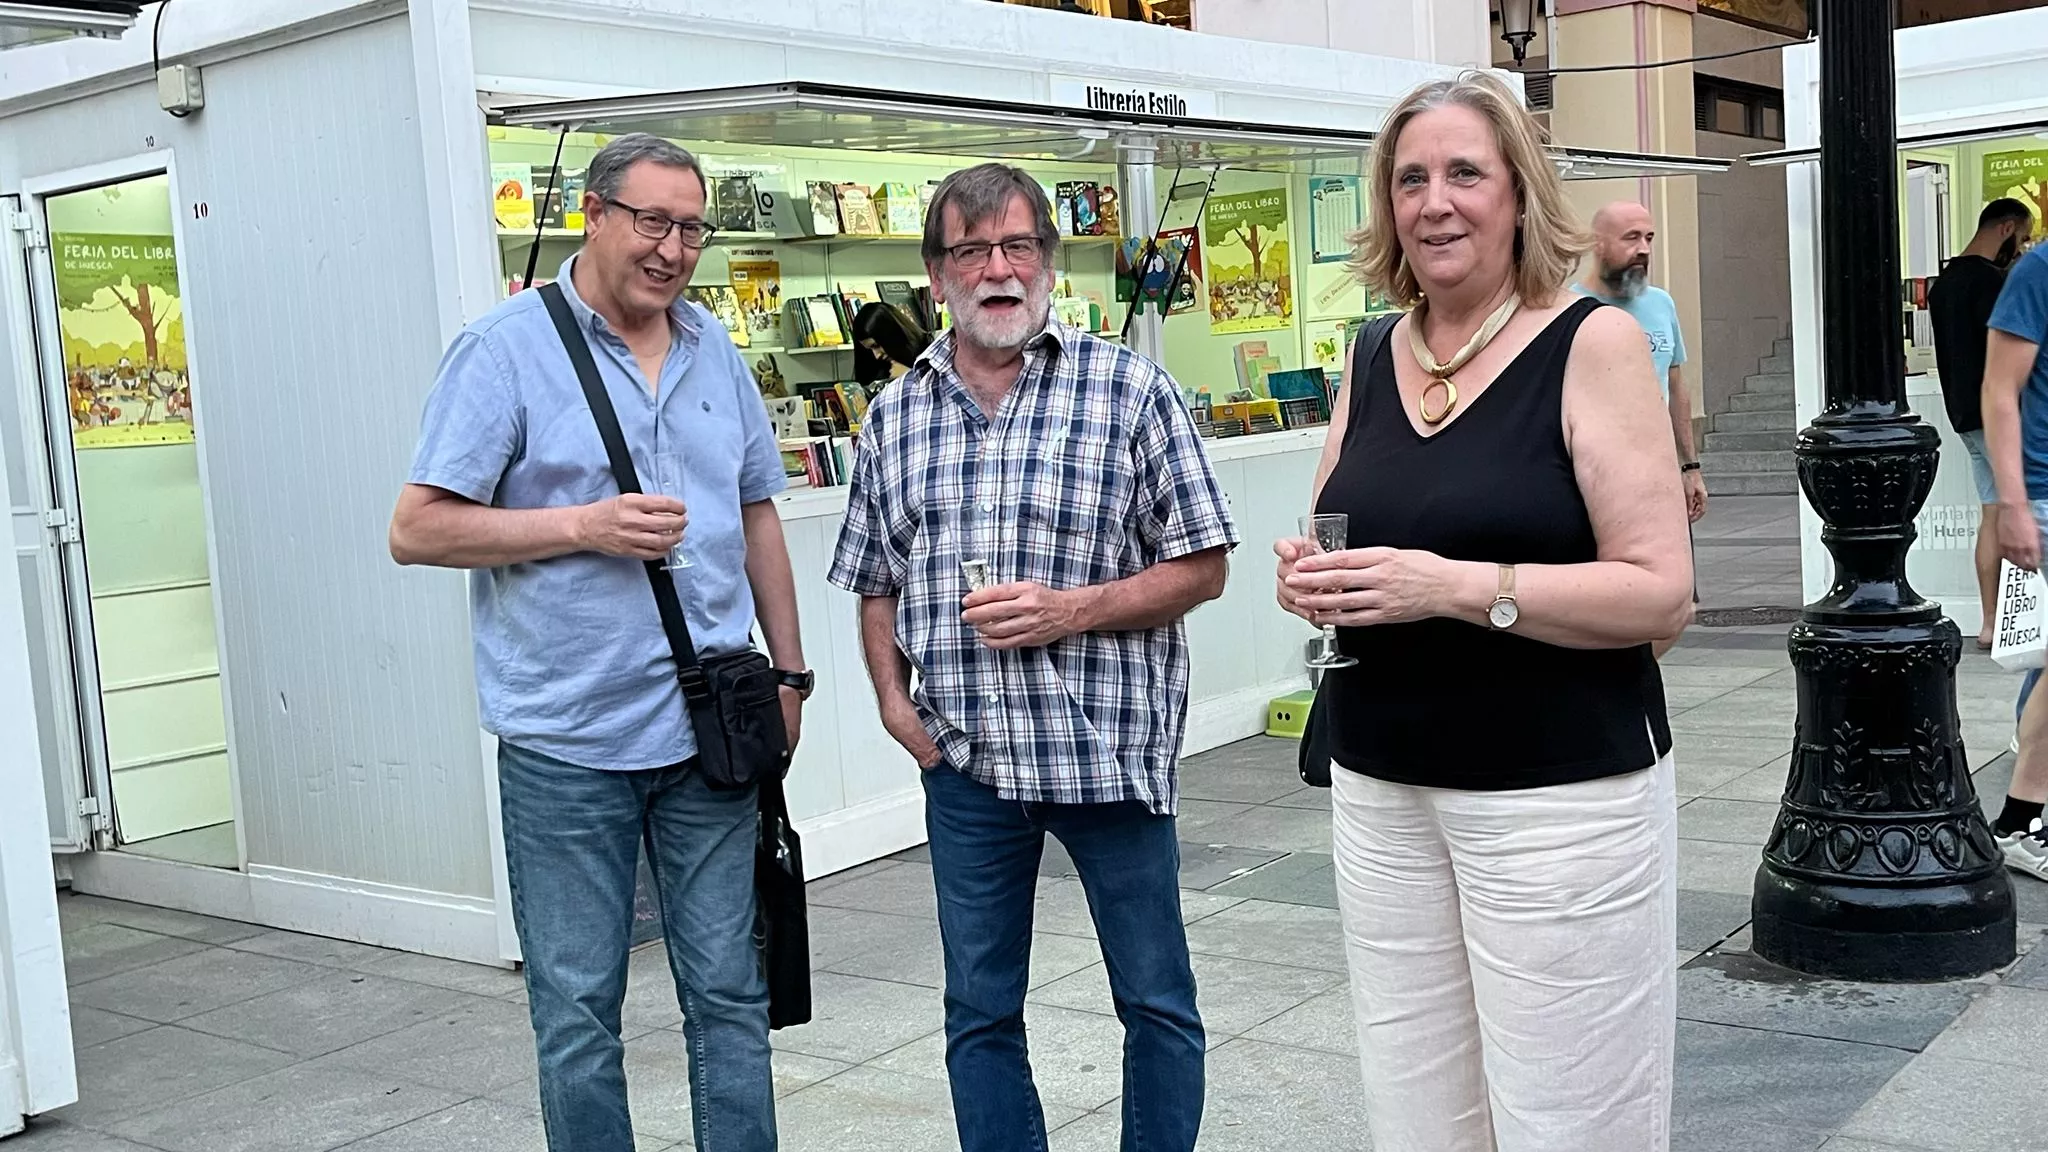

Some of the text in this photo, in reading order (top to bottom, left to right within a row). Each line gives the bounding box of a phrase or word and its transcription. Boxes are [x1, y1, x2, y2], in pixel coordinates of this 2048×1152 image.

[1086, 86, 1146, 113] Librería
[145, 135, 155, 148] 10
[1990, 157, 2044, 170] FERIA DEL
[193, 202, 209, 219] 10
[1209, 197, 1280, 213] FERIA DEL LIBRO
[64, 245, 106, 259] FERIA
[111, 246, 139, 259] DEL
[64, 260, 113, 270] DE HUESCA
[2005, 582, 2027, 600] DEL
[2003, 595, 2037, 616] LIBRO
[2001, 615, 2018, 632] DE
[1999, 626, 2041, 648] HUESCA
